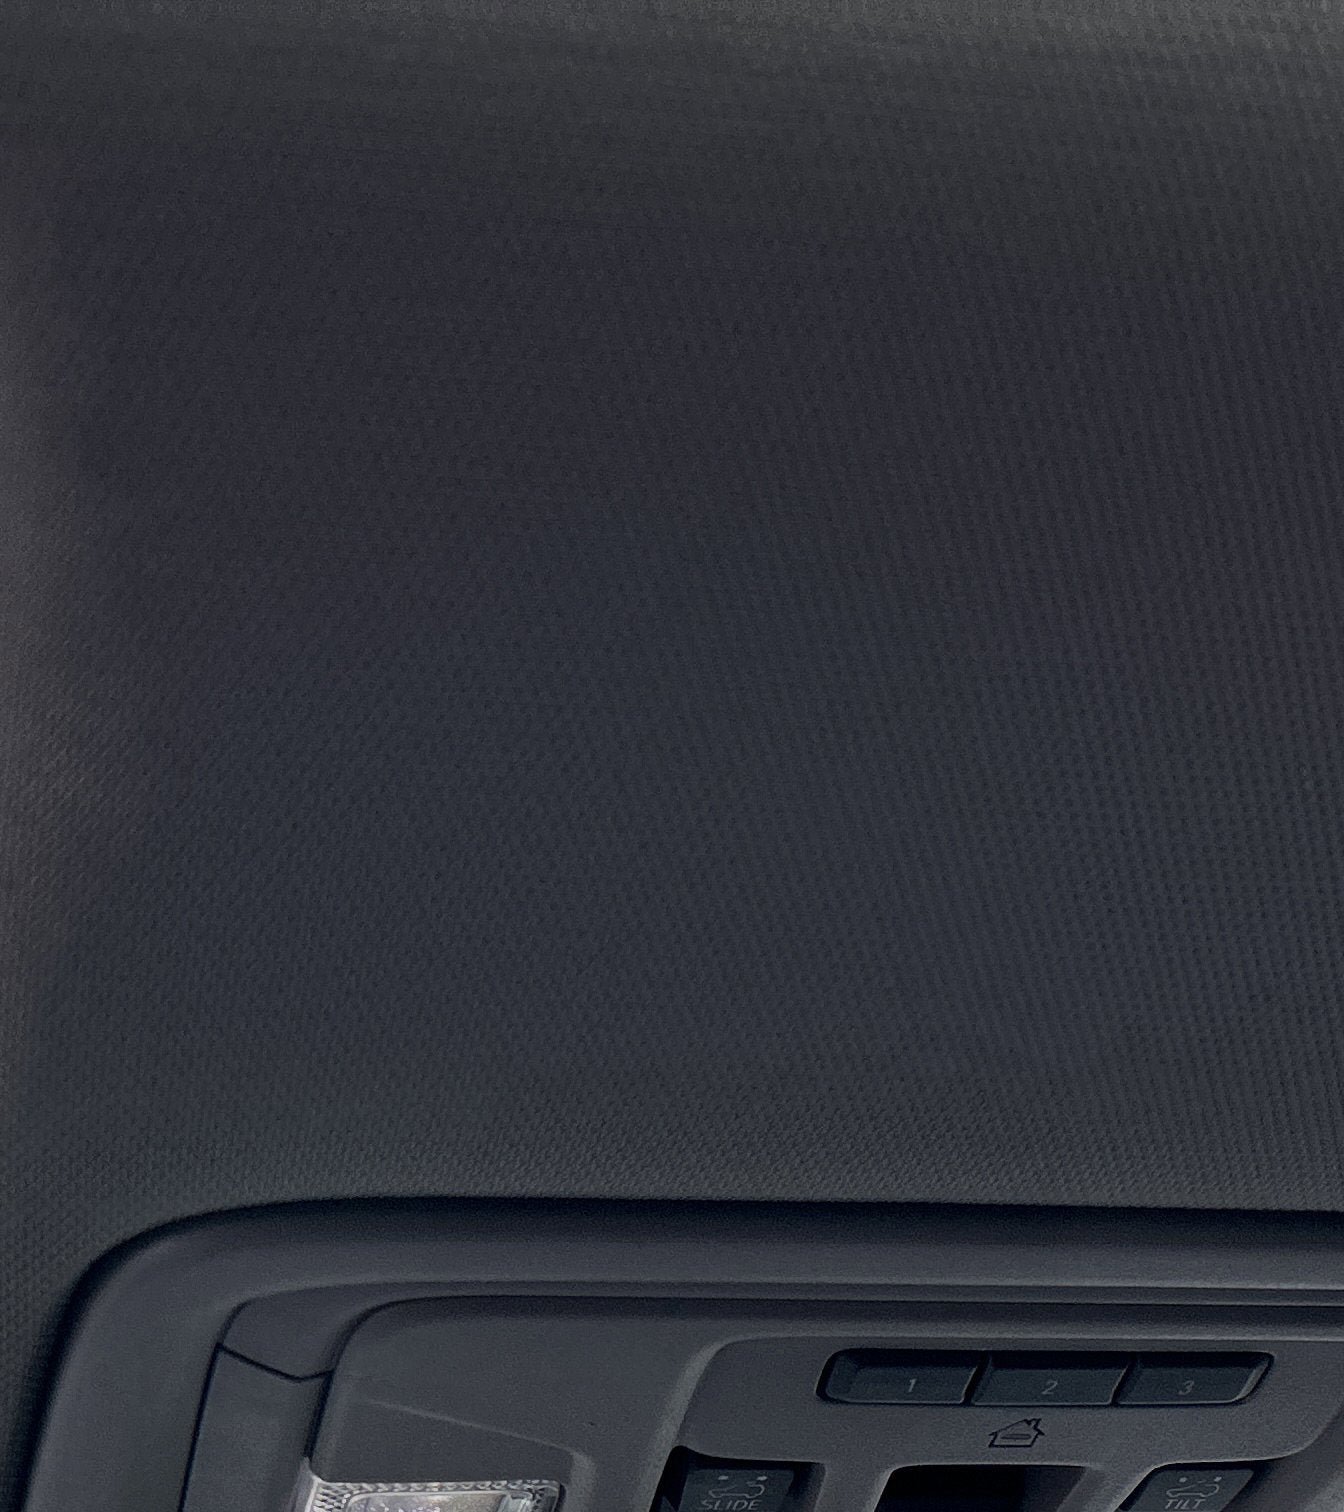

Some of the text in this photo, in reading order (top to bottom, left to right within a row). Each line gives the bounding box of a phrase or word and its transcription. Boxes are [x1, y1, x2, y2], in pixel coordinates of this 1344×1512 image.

[906, 1378, 918, 1393] 1
[1041, 1379, 1058, 1395] 2
[1178, 1379, 1195, 1395] 3
[700, 1499, 762, 1511] SLIDE
[1164, 1499, 1206, 1510] TILT
